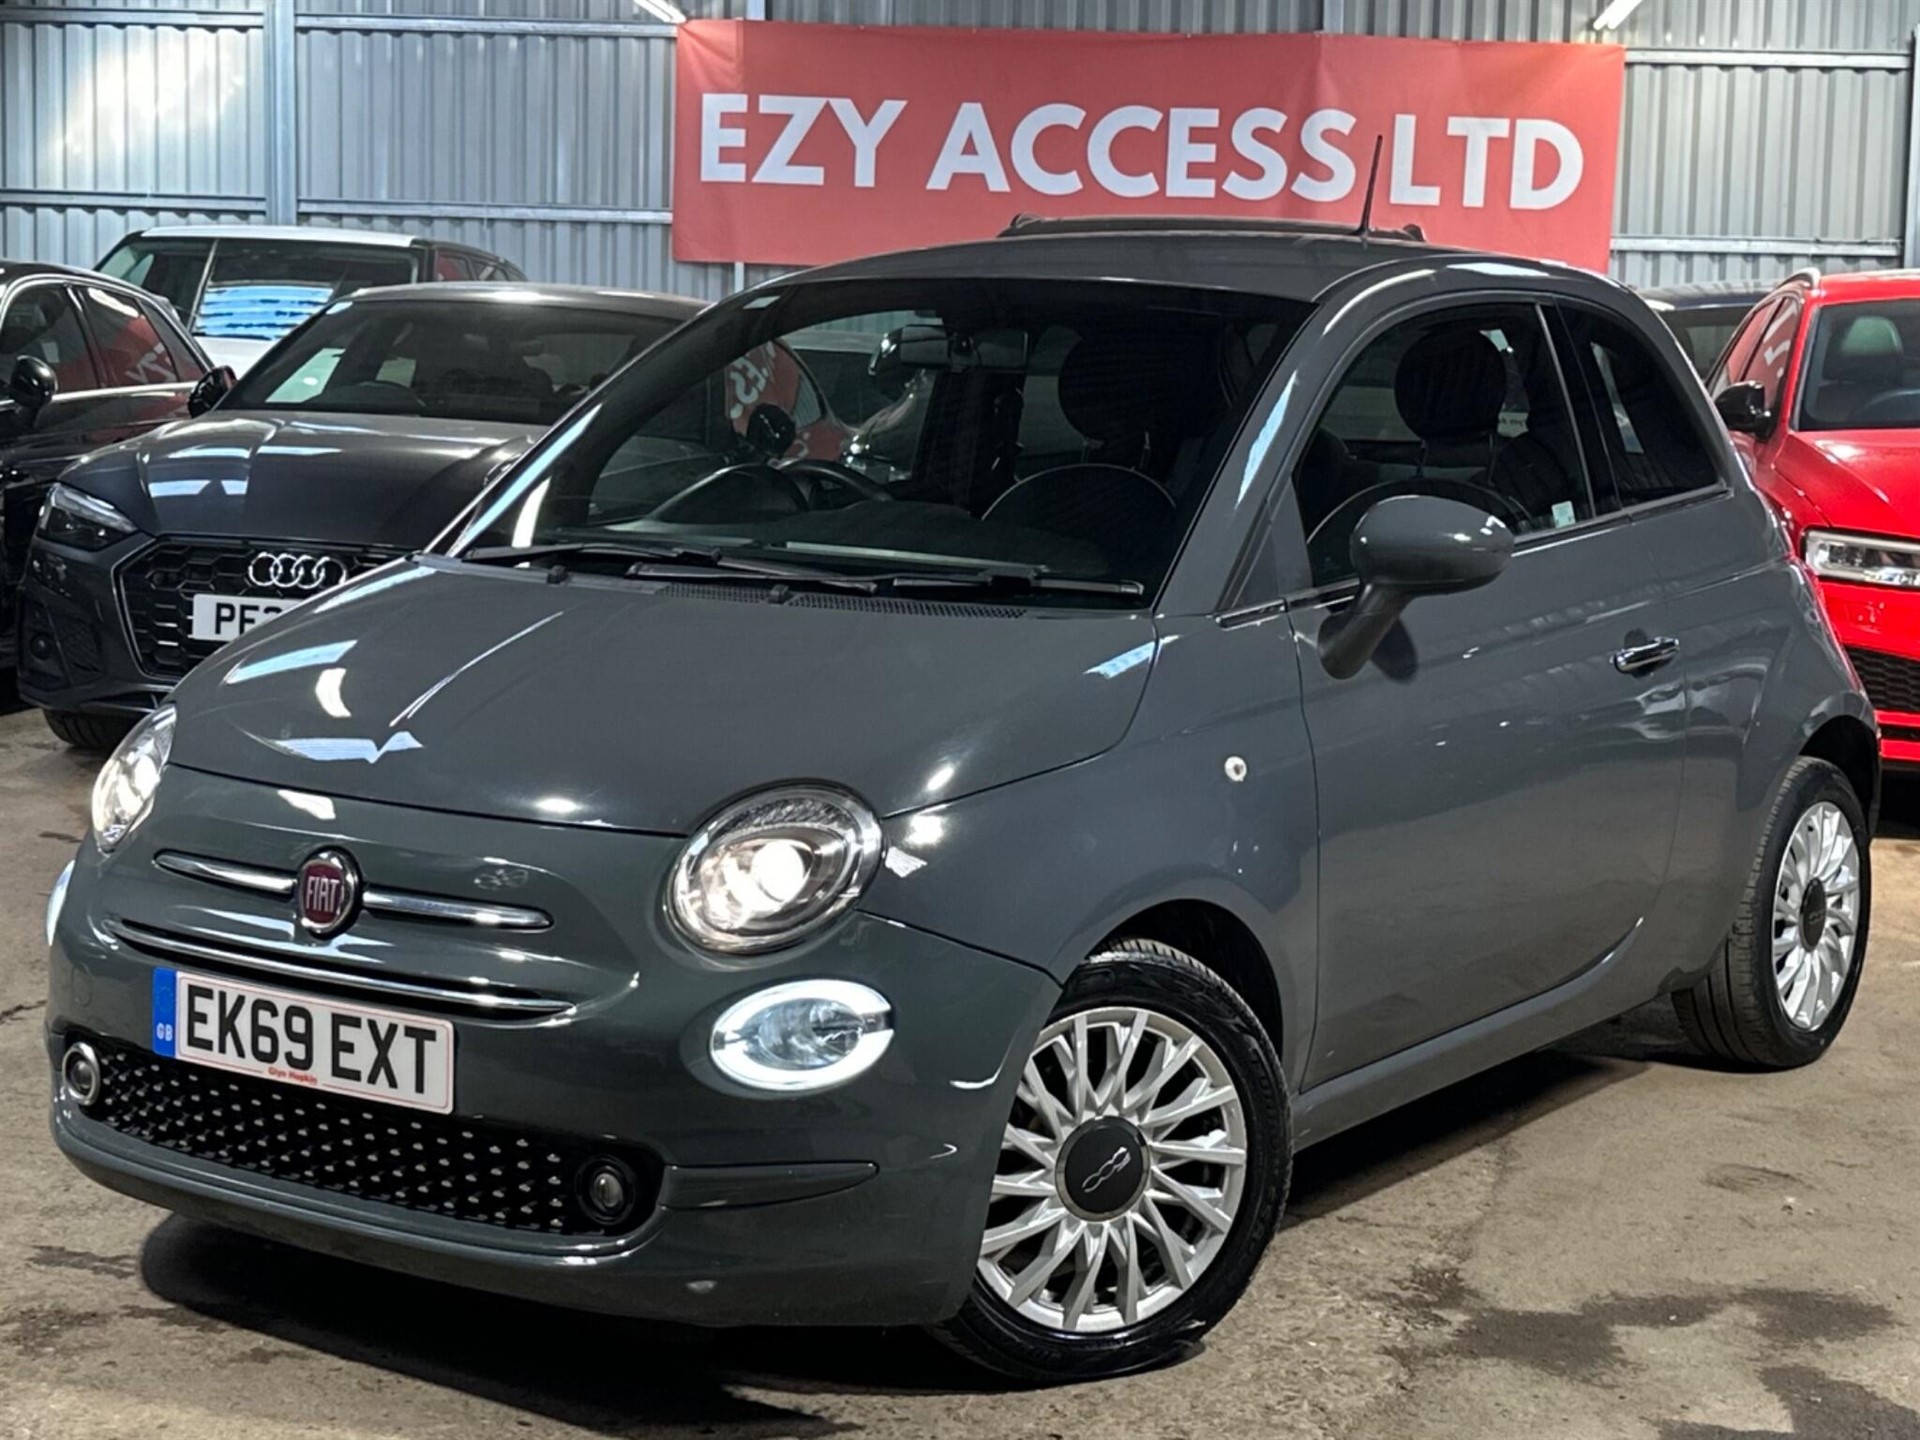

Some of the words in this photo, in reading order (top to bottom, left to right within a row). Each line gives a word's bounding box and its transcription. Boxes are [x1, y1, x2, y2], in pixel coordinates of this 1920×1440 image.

[700, 92, 908, 188] EZY
[925, 101, 1358, 204] ACCESS
[1389, 113, 1584, 211] LTD
[305, 875, 340, 913] FIAT
[156, 1021, 173, 1042] GB
[186, 983, 314, 1072] EK69
[330, 1011, 437, 1095] EXT
